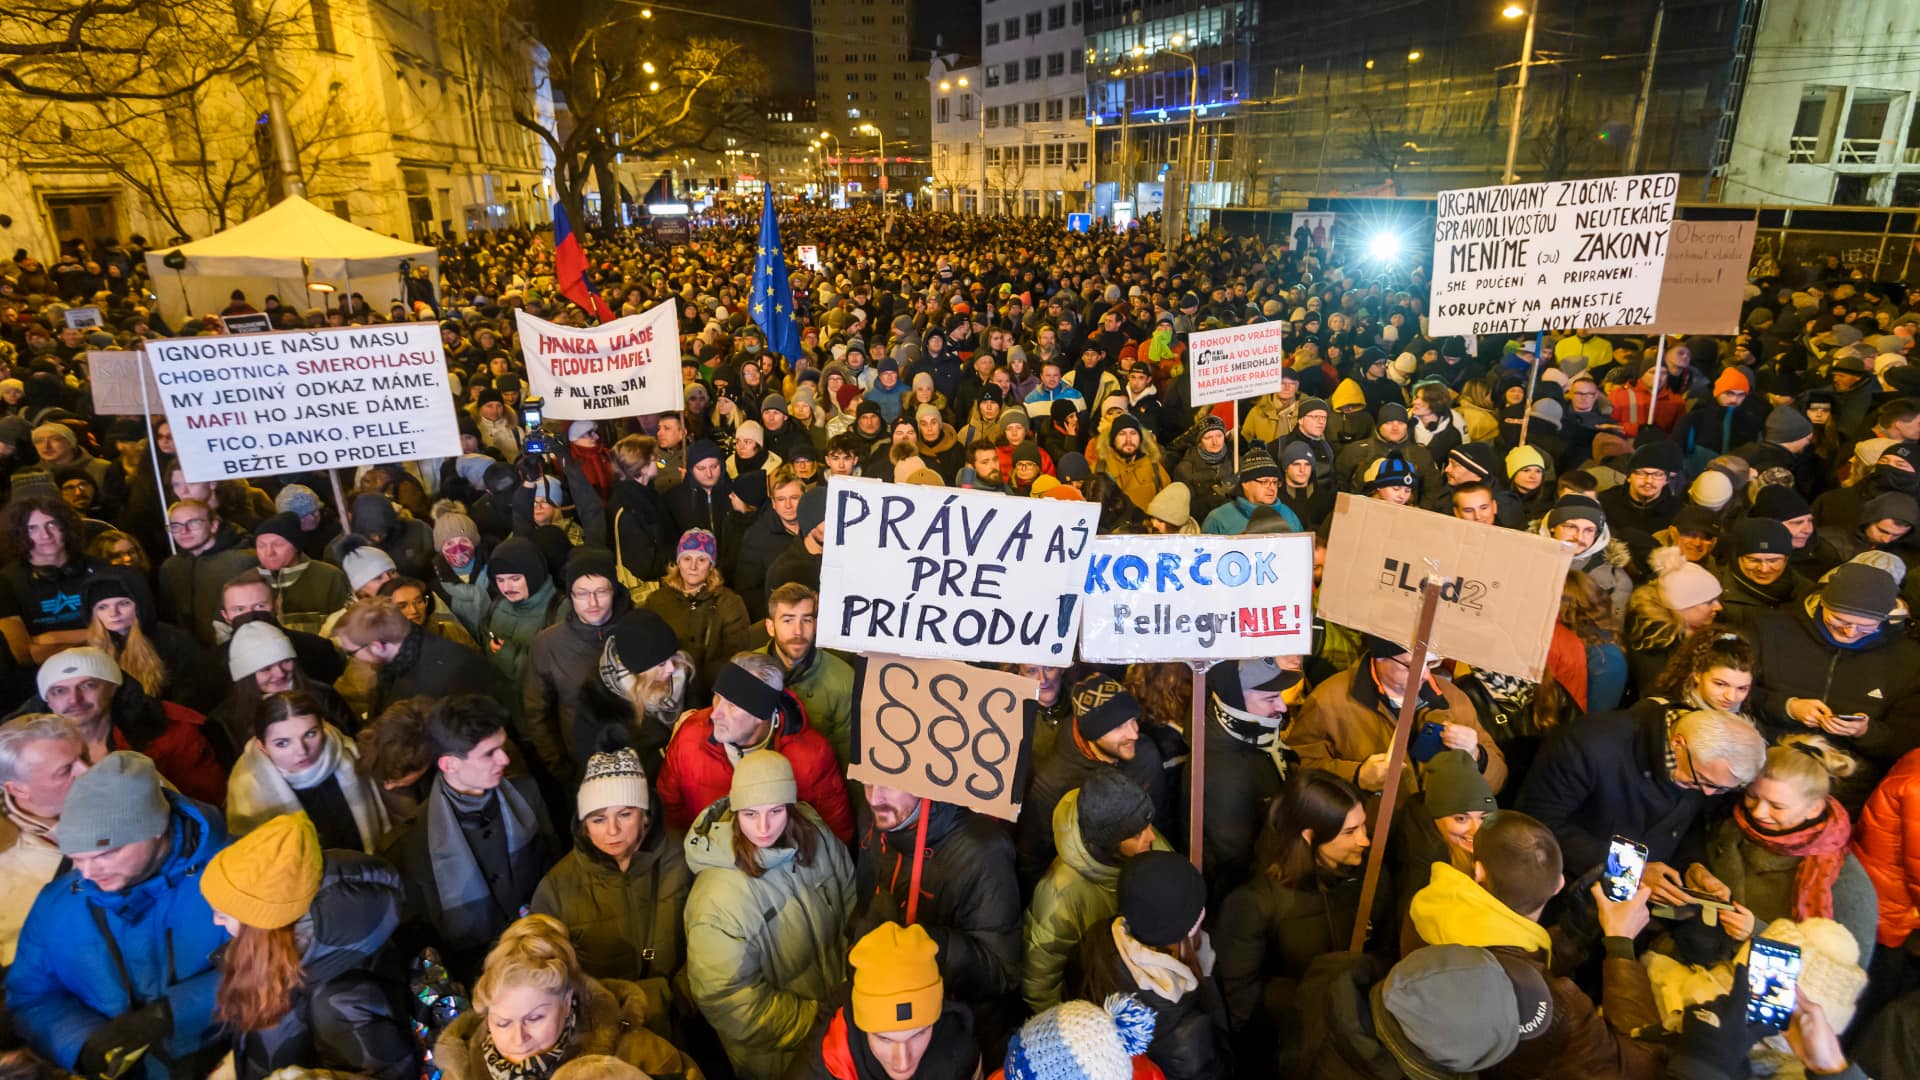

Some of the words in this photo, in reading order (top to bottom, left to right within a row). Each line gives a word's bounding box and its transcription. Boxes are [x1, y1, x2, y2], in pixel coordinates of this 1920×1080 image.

[1556, 180, 1618, 207] ZLOČIN:
[1626, 176, 1677, 201] PRED
[1449, 238, 1530, 274] MENÍME
[1537, 249, 1560, 265] (JU)
[1537, 273, 1547, 286] A
[1438, 298, 1517, 318] KORUPČNÝ
[1522, 299, 1541, 313] NA
[1550, 292, 1623, 310] AMNESTIE
[1472, 313, 1530, 335] BOHATÝ
[1541, 311, 1581, 331] NOVÝ
[1584, 312, 1610, 329] ROK
[1616, 306, 1652, 326] 2024
[158, 340, 273, 362] IGNORUJE
[281, 331, 340, 354] NAŠU
[350, 331, 409, 350] MASU
[539, 334, 599, 355] HANBA
[1192, 341, 1198, 349] 6
[1200, 336, 1231, 348] ROKOV
[1234, 334, 1245, 342] PO
[1237, 349, 1250, 358] VO
[159, 364, 289, 386] CHOBOTNICA
[551, 357, 603, 376] FICOVEJ
[607, 348, 652, 371] MAFIE!
[1198, 367, 1210, 377] TIE
[171, 392, 203, 409] MY
[212, 382, 286, 405] JEDINÝ
[296, 379, 366, 398] ODKAZ
[372, 372, 440, 390] MÁME,
[570, 386, 589, 397] ALL
[593, 383, 616, 395] FOR
[621, 376, 646, 393] JAN
[187, 411, 247, 429] MAFII
[255, 408, 286, 424] HO
[293, 400, 359, 420] JASNE
[366, 395, 429, 414] DÁME:
[224, 454, 288, 474] BEŽTE
[299, 452, 329, 467] DO
[335, 441, 417, 463] PRDELE!
[836, 490, 1033, 562] PRÁVA
[907, 556, 1007, 599] PRE
[1084, 548, 1279, 595] KORČOK
[841, 593, 1078, 655] PRÍRODU!
[1113, 604, 1301, 648] PellegriNIE!
